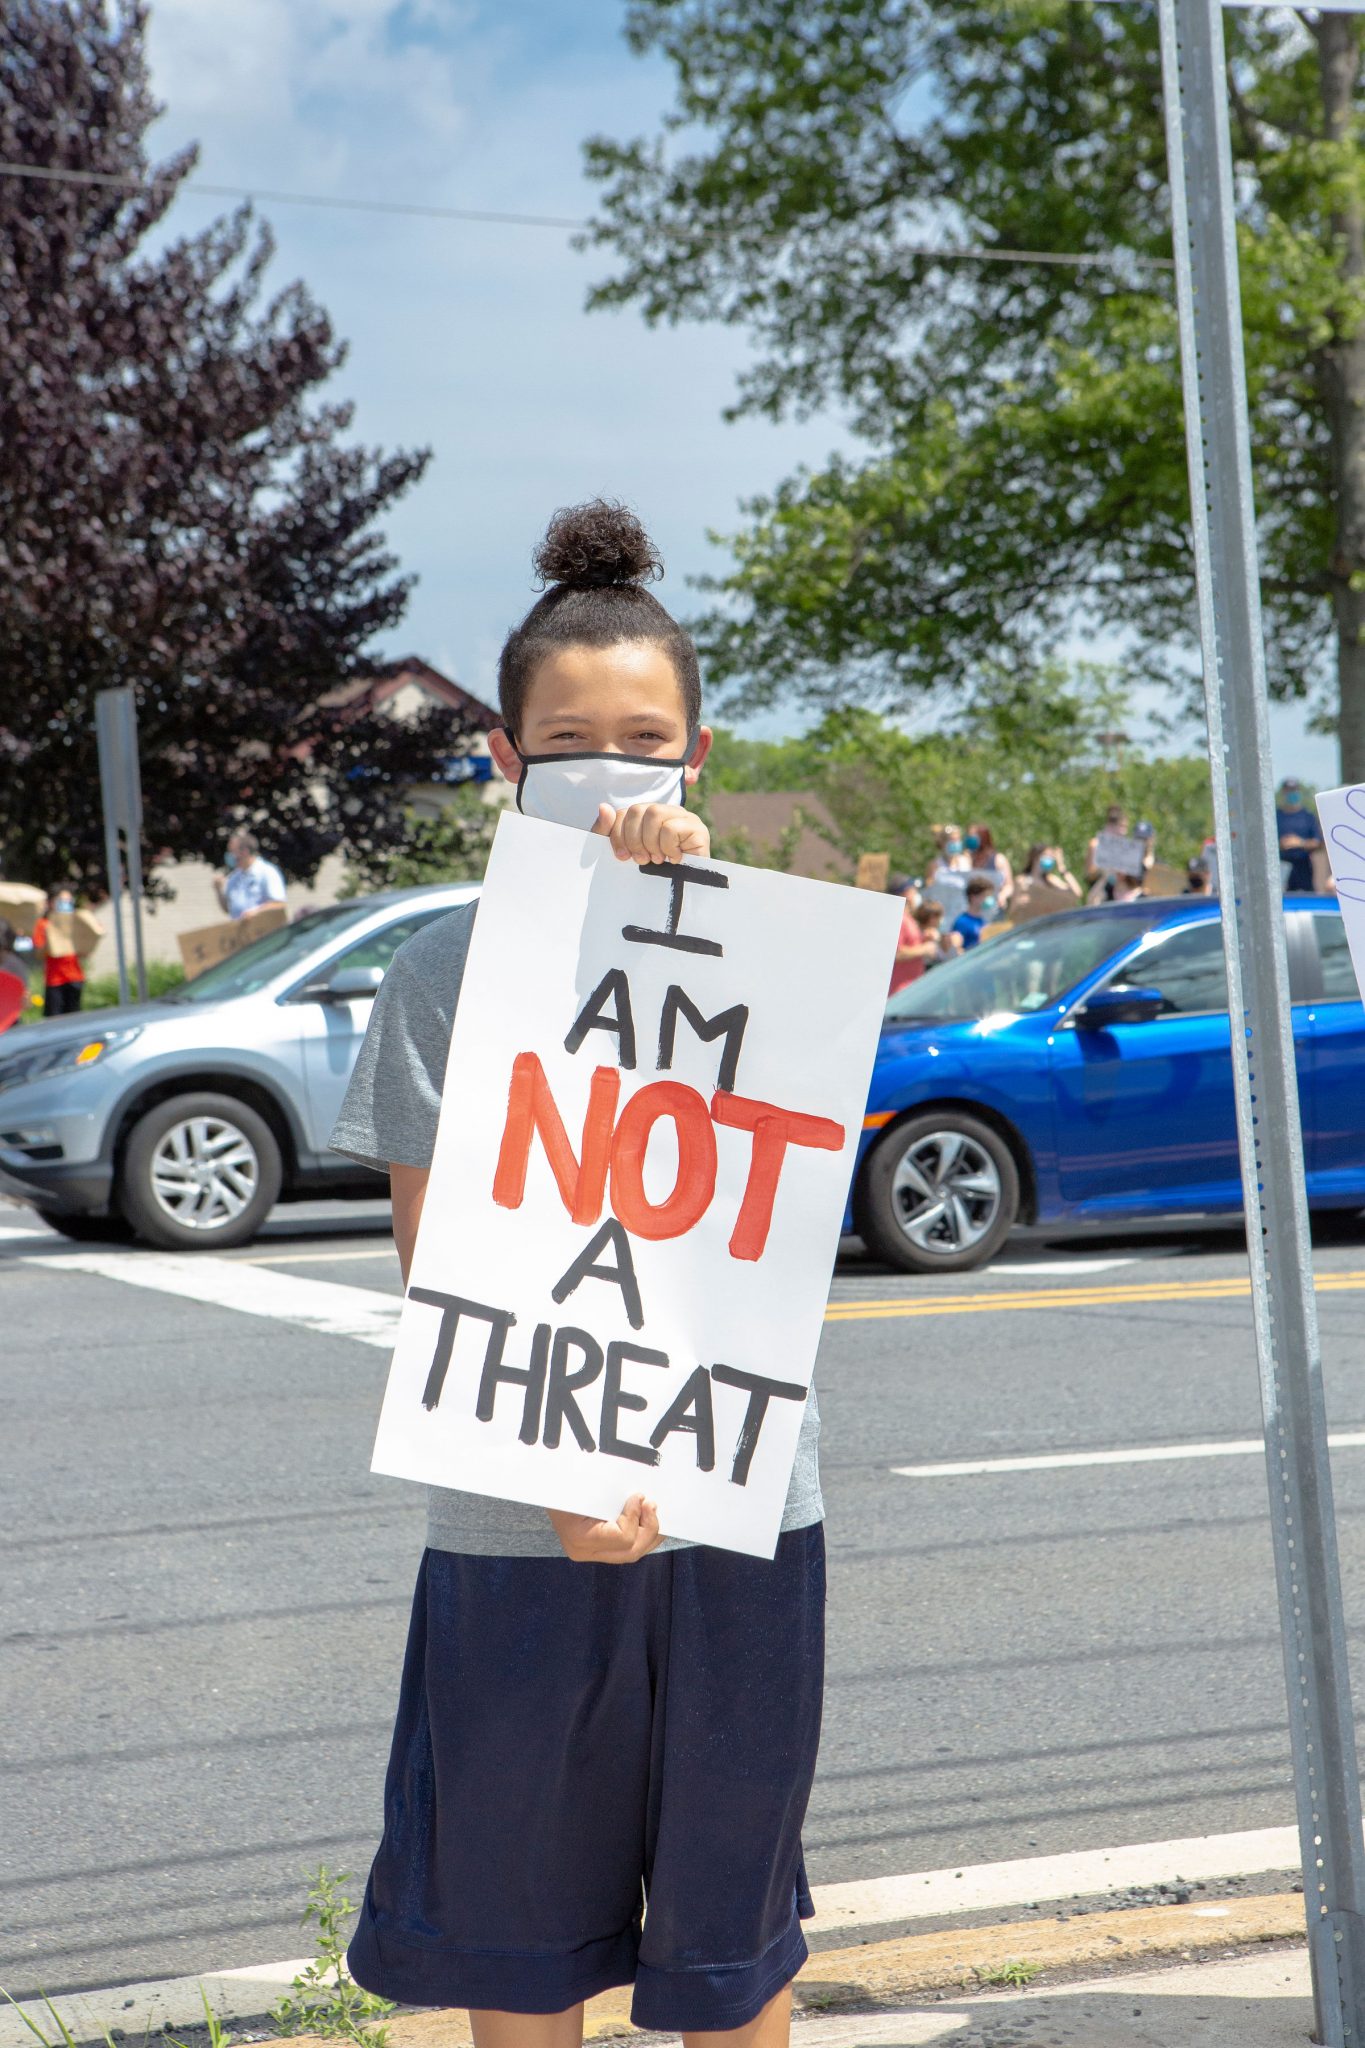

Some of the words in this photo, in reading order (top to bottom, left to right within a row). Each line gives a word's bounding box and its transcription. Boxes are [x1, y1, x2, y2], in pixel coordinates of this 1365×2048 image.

[622, 860, 729, 957] I
[565, 969, 748, 1092] AM
[493, 1052, 845, 1261] NOT
[552, 1218, 643, 1330] A
[409, 1287, 807, 1486] THREAT
